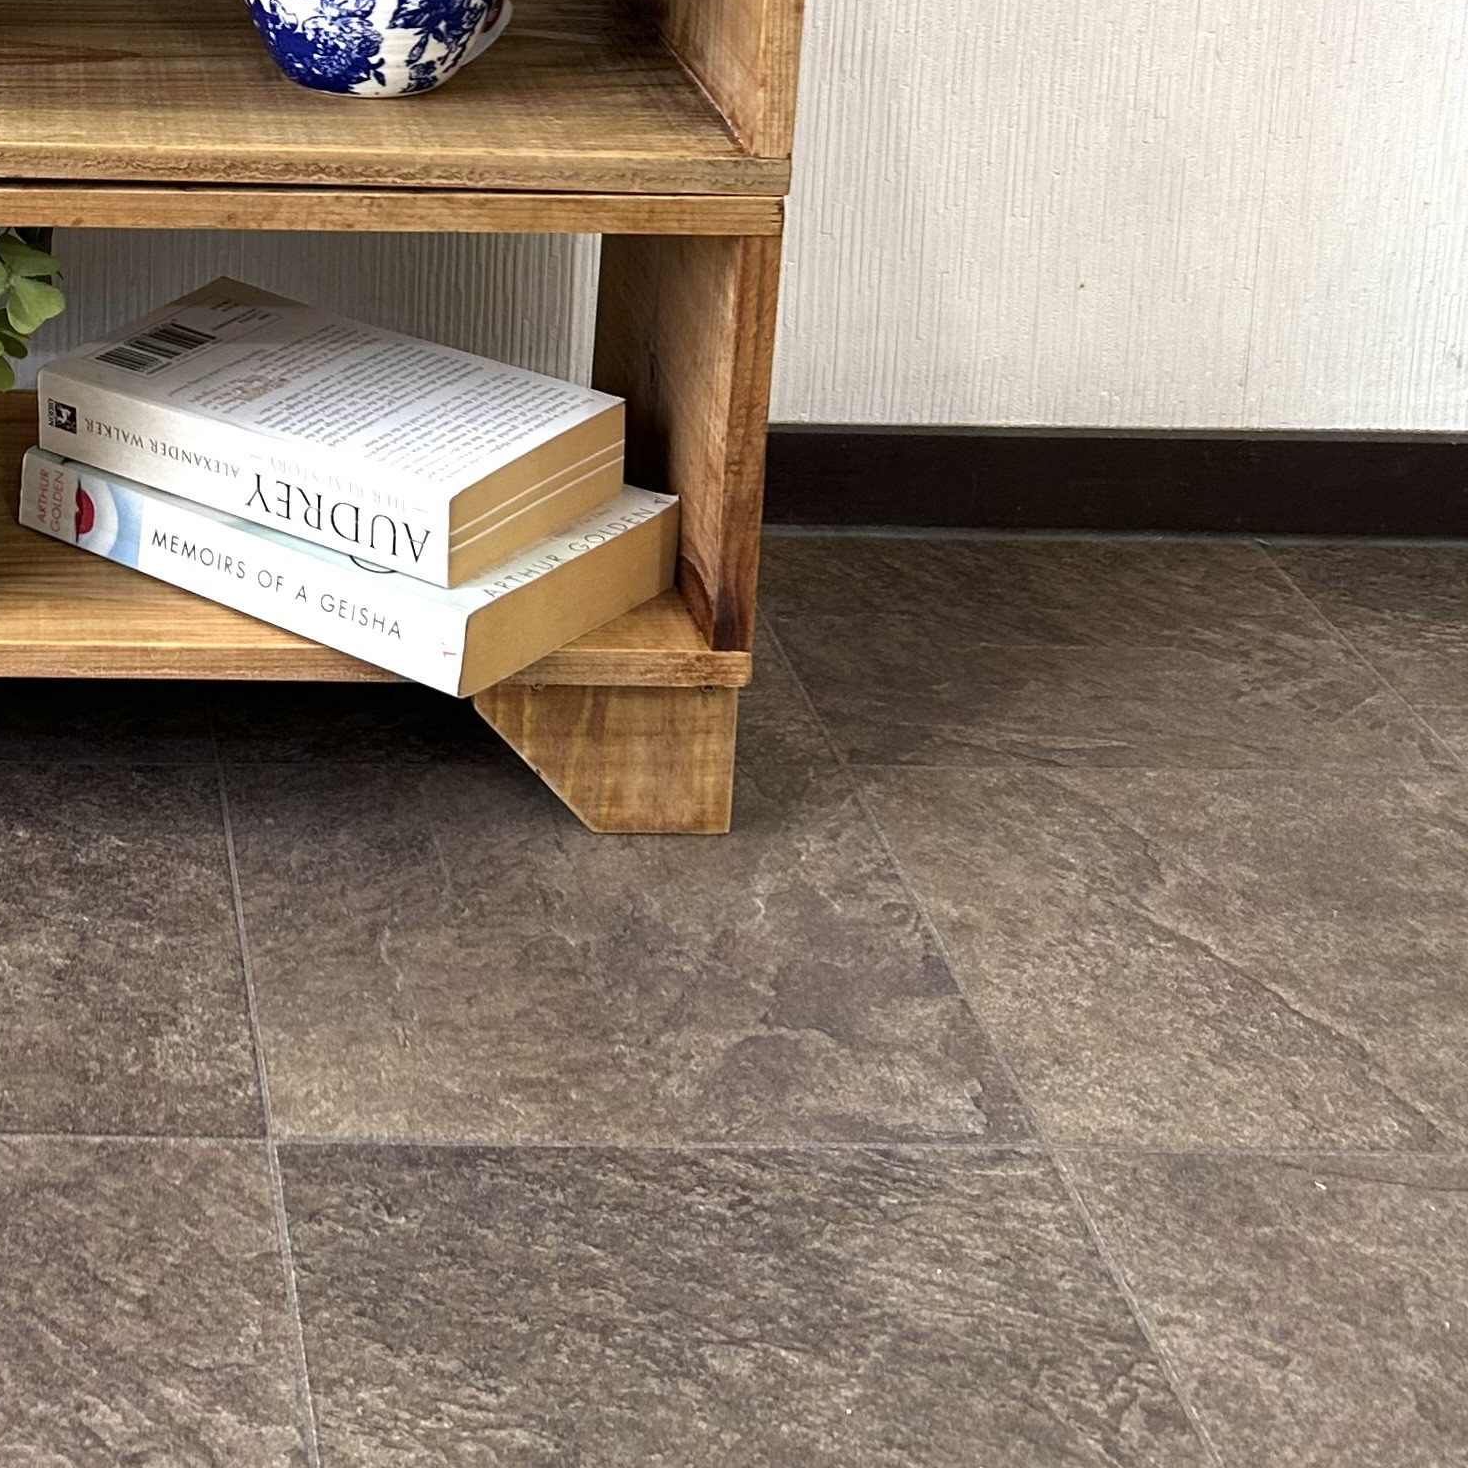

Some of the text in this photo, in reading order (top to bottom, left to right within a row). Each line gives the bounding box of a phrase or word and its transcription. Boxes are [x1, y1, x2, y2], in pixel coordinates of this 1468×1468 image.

[84, 418, 240, 478] ALEXANDER WALKER
[37, 468, 50, 524] ARTHUR
[50, 470, 64, 532] GOLDEN
[245, 473, 431, 563] AUDREY
[151, 529, 401, 639] MEMOIRS OF A GEISHA
[483, 554, 566, 598] ARTHUR
[568, 507, 654, 552] GOLDEN
